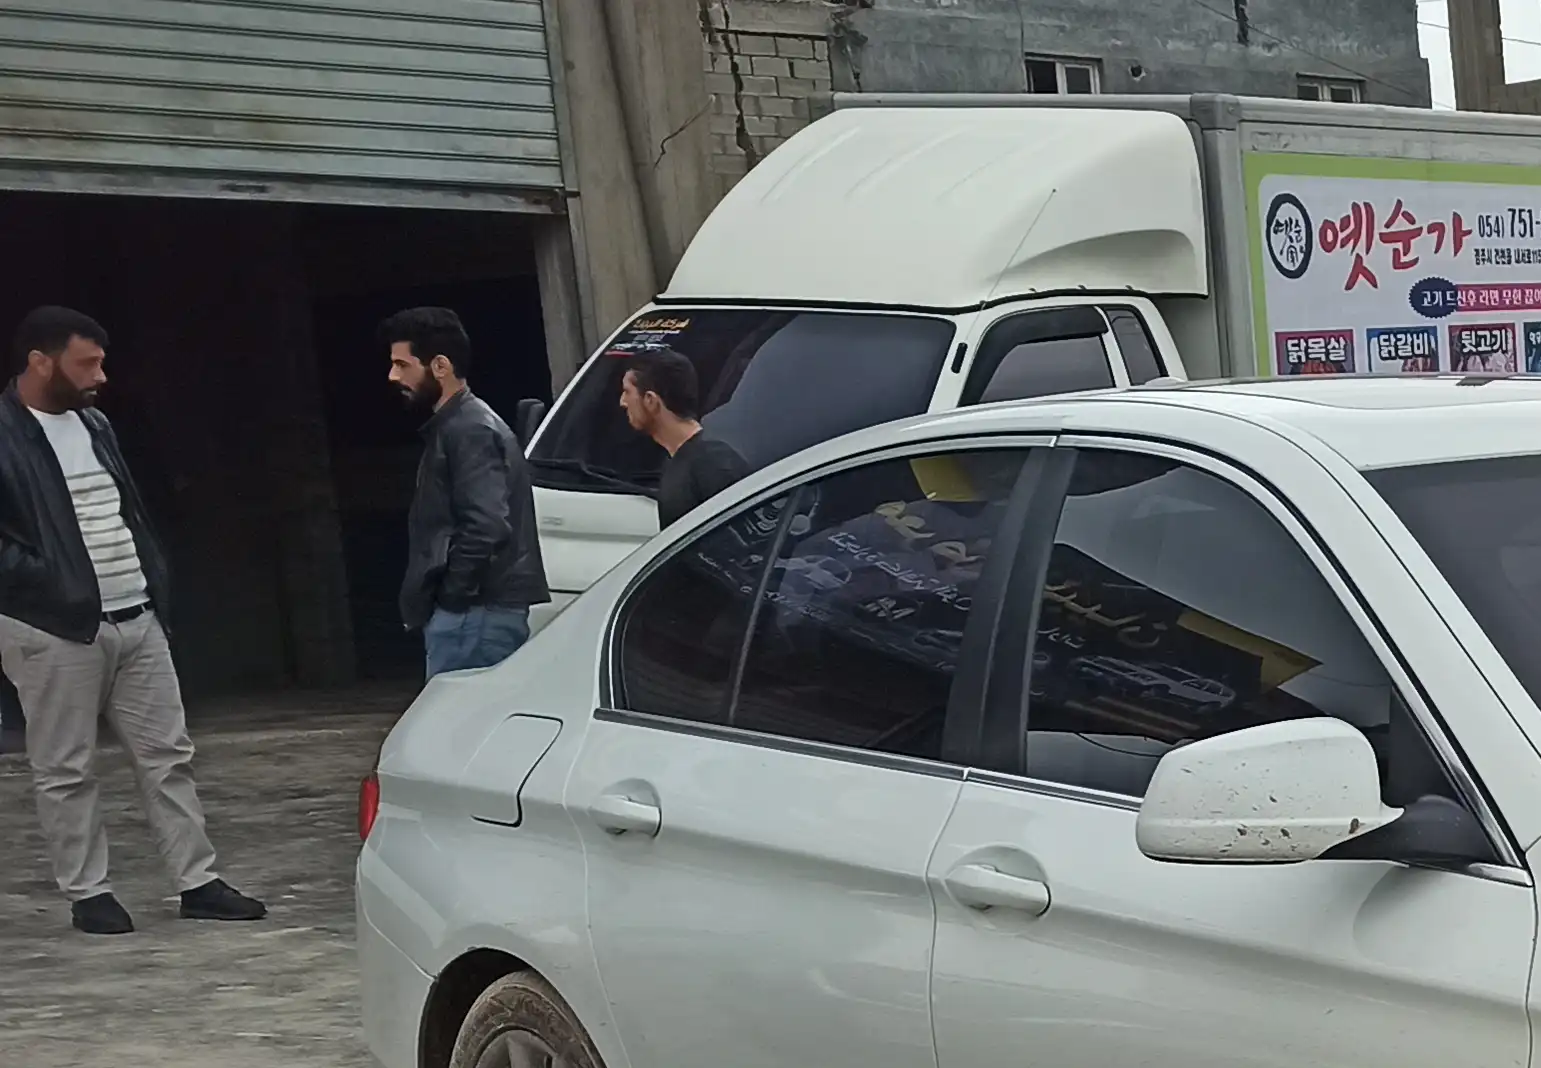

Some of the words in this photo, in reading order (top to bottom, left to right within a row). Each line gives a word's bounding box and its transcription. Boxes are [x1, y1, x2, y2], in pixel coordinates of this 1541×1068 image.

[1478, 214, 1505, 239] 054)
[1318, 198, 1473, 291] 옛순가
[1421, 290, 1443, 307] 고기
[1479, 288, 1500, 306] 라면
[1286, 337, 1346, 364] 닭목살
[1379, 332, 1429, 358] 닭갈비
[1461, 329, 1507, 353] 뒷고기
